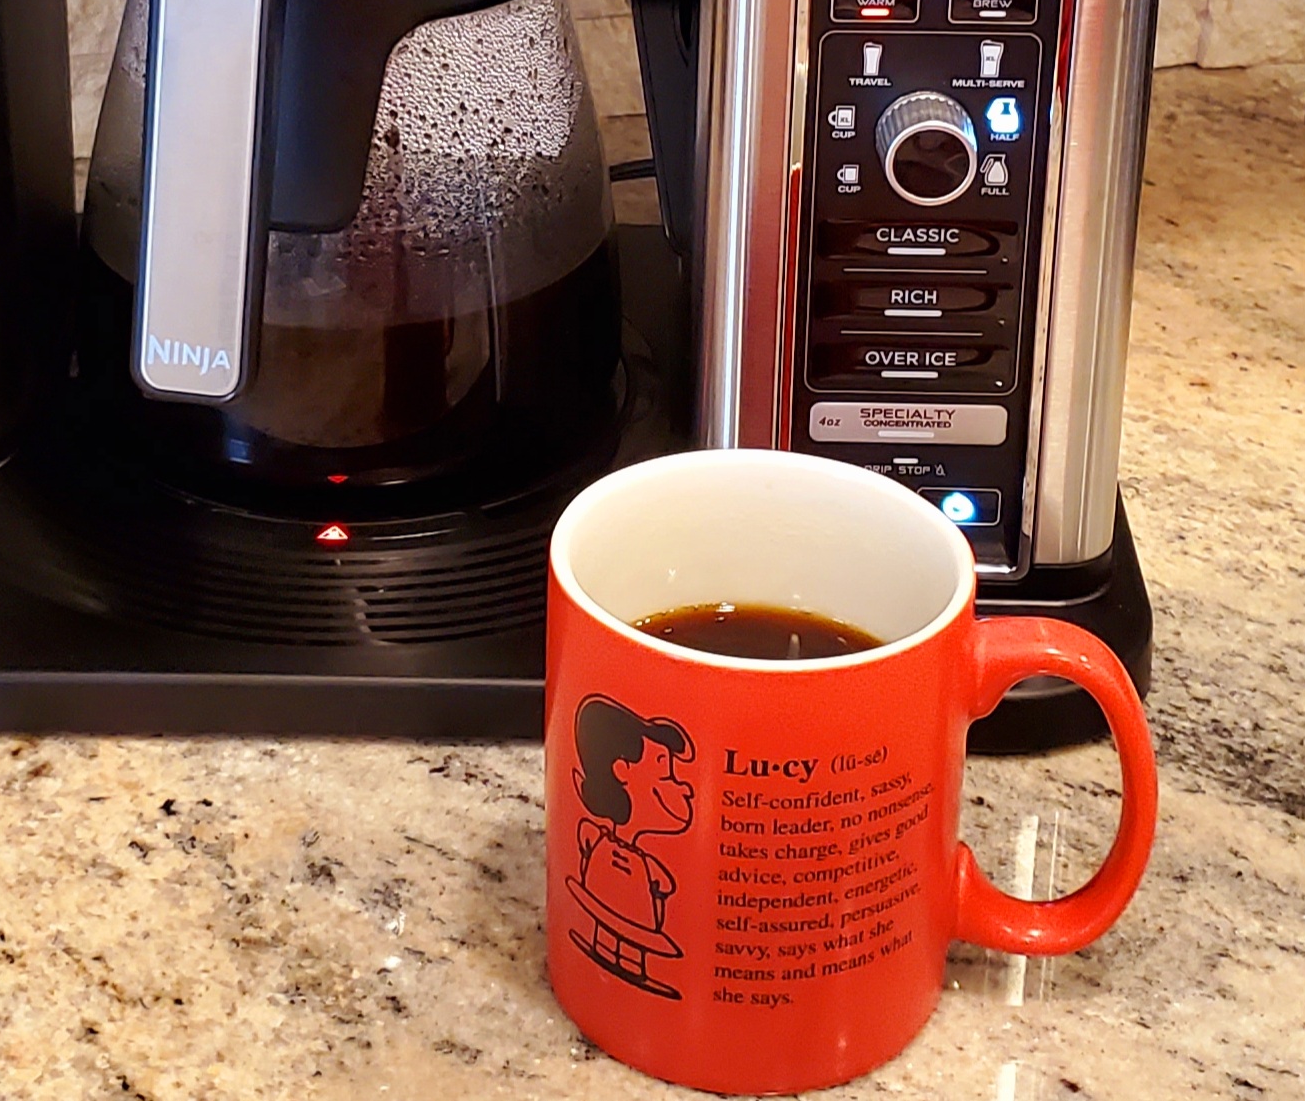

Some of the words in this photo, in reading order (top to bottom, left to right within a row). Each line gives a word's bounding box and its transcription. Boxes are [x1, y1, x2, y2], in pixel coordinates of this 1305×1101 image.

[972, 0, 1013, 9] BREW
[849, 78, 892, 87] TRAVEL
[951, 79, 1025, 88] MULTI-SERVE
[839, 116, 851, 124] XL
[831, 130, 856, 139] CUP
[990, 133, 1020, 142] HALF
[837, 185, 862, 194] CUP
[981, 187, 1009, 196] FULL
[875, 227, 961, 243] CLASSIC
[890, 289, 938, 305] RICH
[147, 334, 231, 376] NINJA
[864, 350, 919, 366] OVER
[925, 351, 957, 367] ICE
[859, 407, 956, 421] SPECIALTY
[818, 416, 841, 428] 4oz
[863, 419, 952, 430] CONCENTRATED
[898, 465, 931, 476] STOP
[721, 788, 865, 810] Self-confident,
[720, 814, 766, 835] born
[840, 813, 863, 830] no
[719, 841, 768, 860] takes
[774, 843, 843, 862] charge,
[848, 829, 890, 856] gives
[895, 804, 928, 840] good
[718, 866, 787, 886] advice,
[715, 940, 771, 961] savvy,
[777, 942, 816, 958] says
[823, 930, 864, 952] what
[869, 919, 894, 940] she
[714, 963, 775, 982] means
[781, 962, 816, 980] and
[821, 951, 875, 976] means
[880, 930, 913, 957] what
[713, 986, 744, 1004] she
[750, 991, 794, 1010] says.
